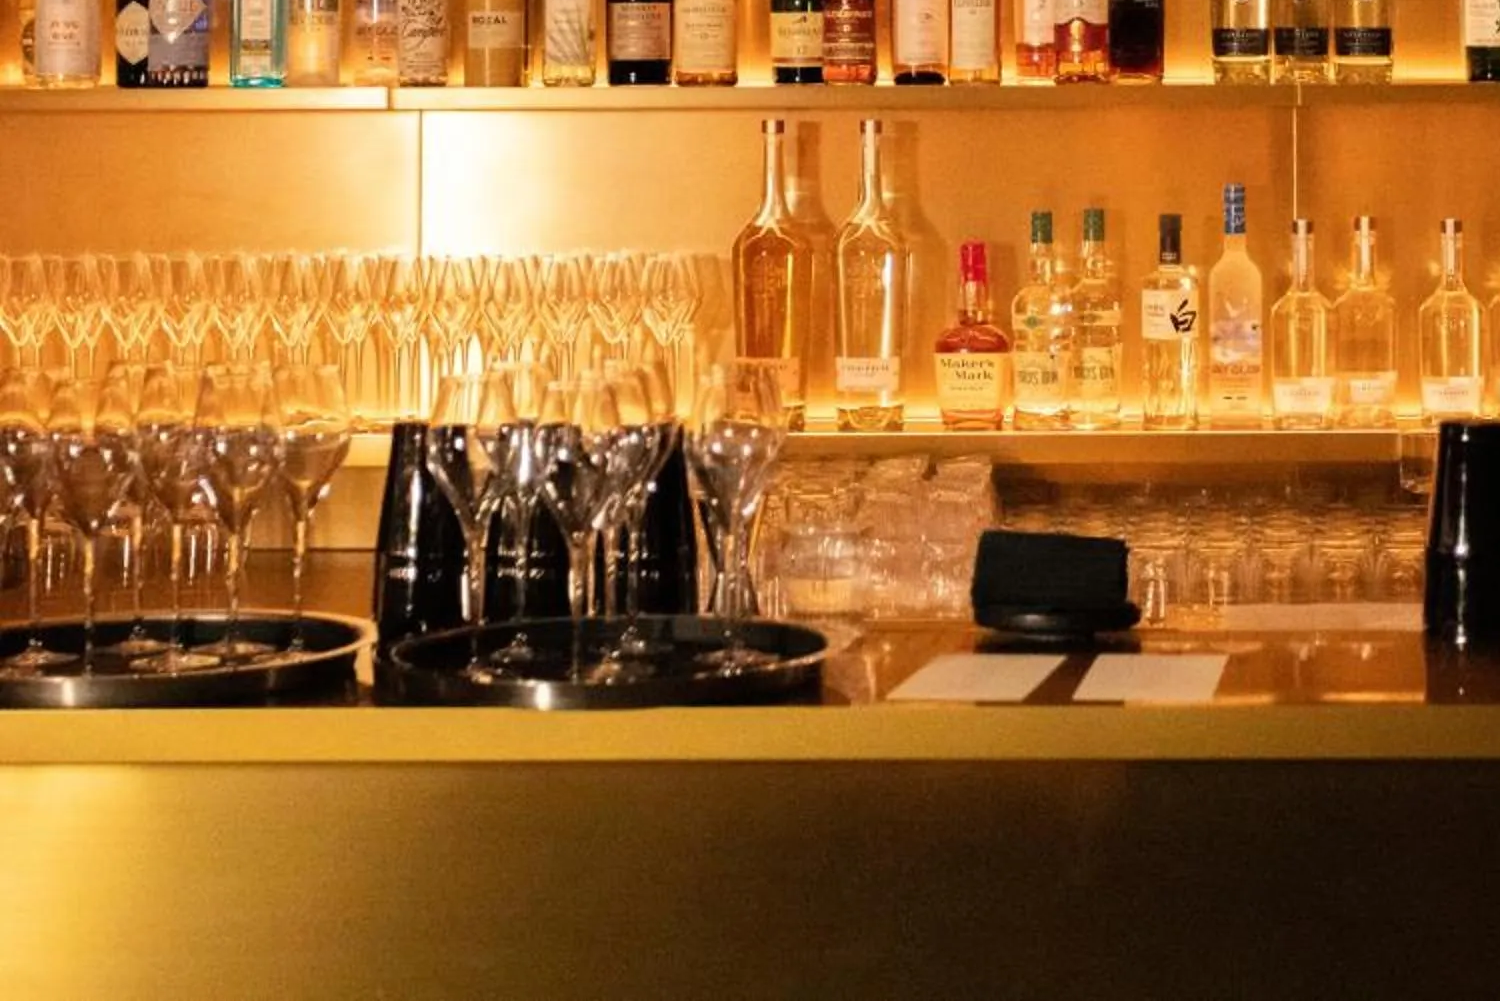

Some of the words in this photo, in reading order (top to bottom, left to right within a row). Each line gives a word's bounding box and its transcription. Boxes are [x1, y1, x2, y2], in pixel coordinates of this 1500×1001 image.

[1169, 298, 1198, 335] 白
[940, 358, 995, 369] Maker's
[955, 370, 994, 381] Mark
